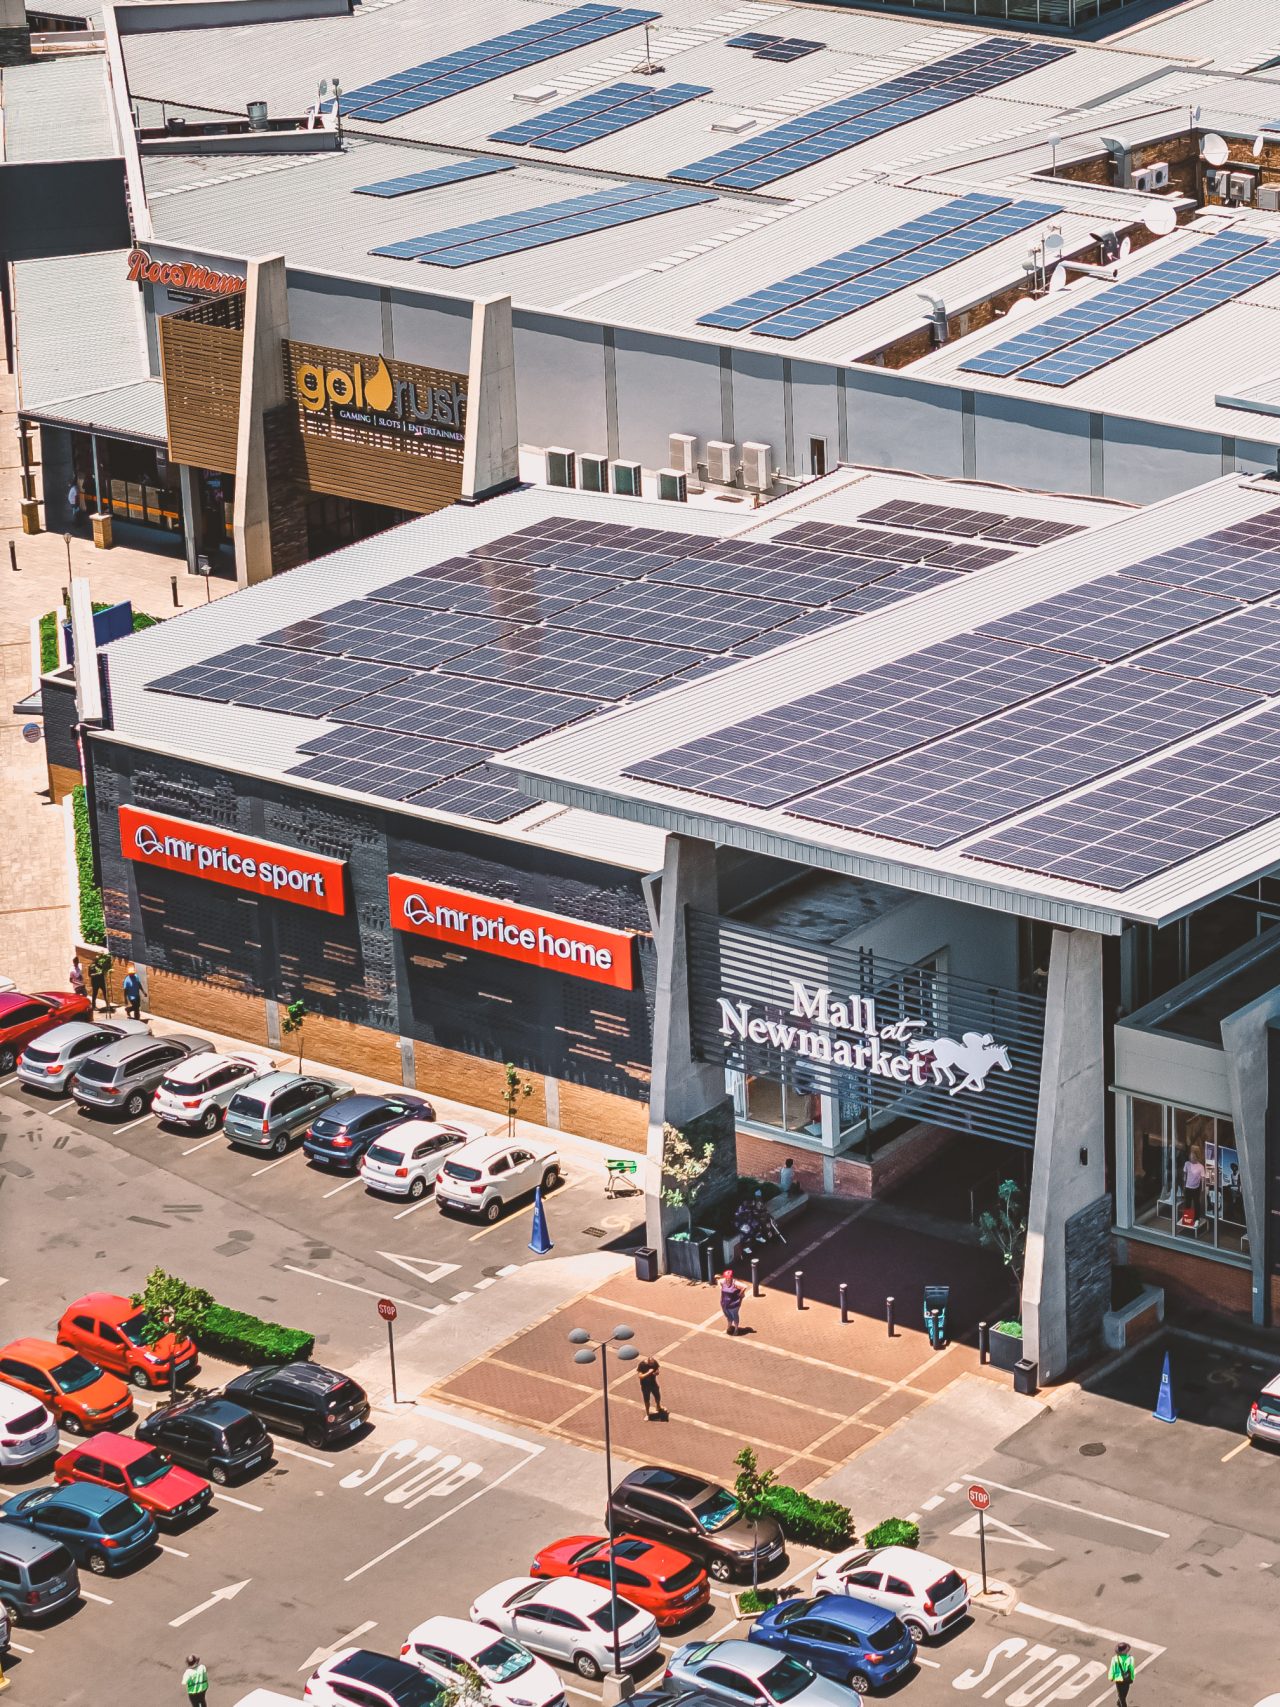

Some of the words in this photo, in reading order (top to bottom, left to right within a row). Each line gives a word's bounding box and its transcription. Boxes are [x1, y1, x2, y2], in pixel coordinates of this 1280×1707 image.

[339, 409, 371, 423] GAMING
[378, 417, 401, 429] SLOTS
[408, 423, 466, 441] ENTERTAINMEN
[164, 836, 195, 861] mr
[198, 845, 256, 877] price
[259, 863, 325, 896] sport
[435, 905, 469, 932] mr
[472, 915, 536, 950] price
[538, 927, 612, 970] home
[716, 997, 928, 1086] Newmarket
[788, 979, 878, 1036] Mall
[880, 1016, 927, 1042] at
[379, 1304, 395, 1316] STOP
[339, 1439, 483, 1509] STOP
[970, 1491, 988, 1503] STOP
[952, 1637, 1108, 1707] STOP
